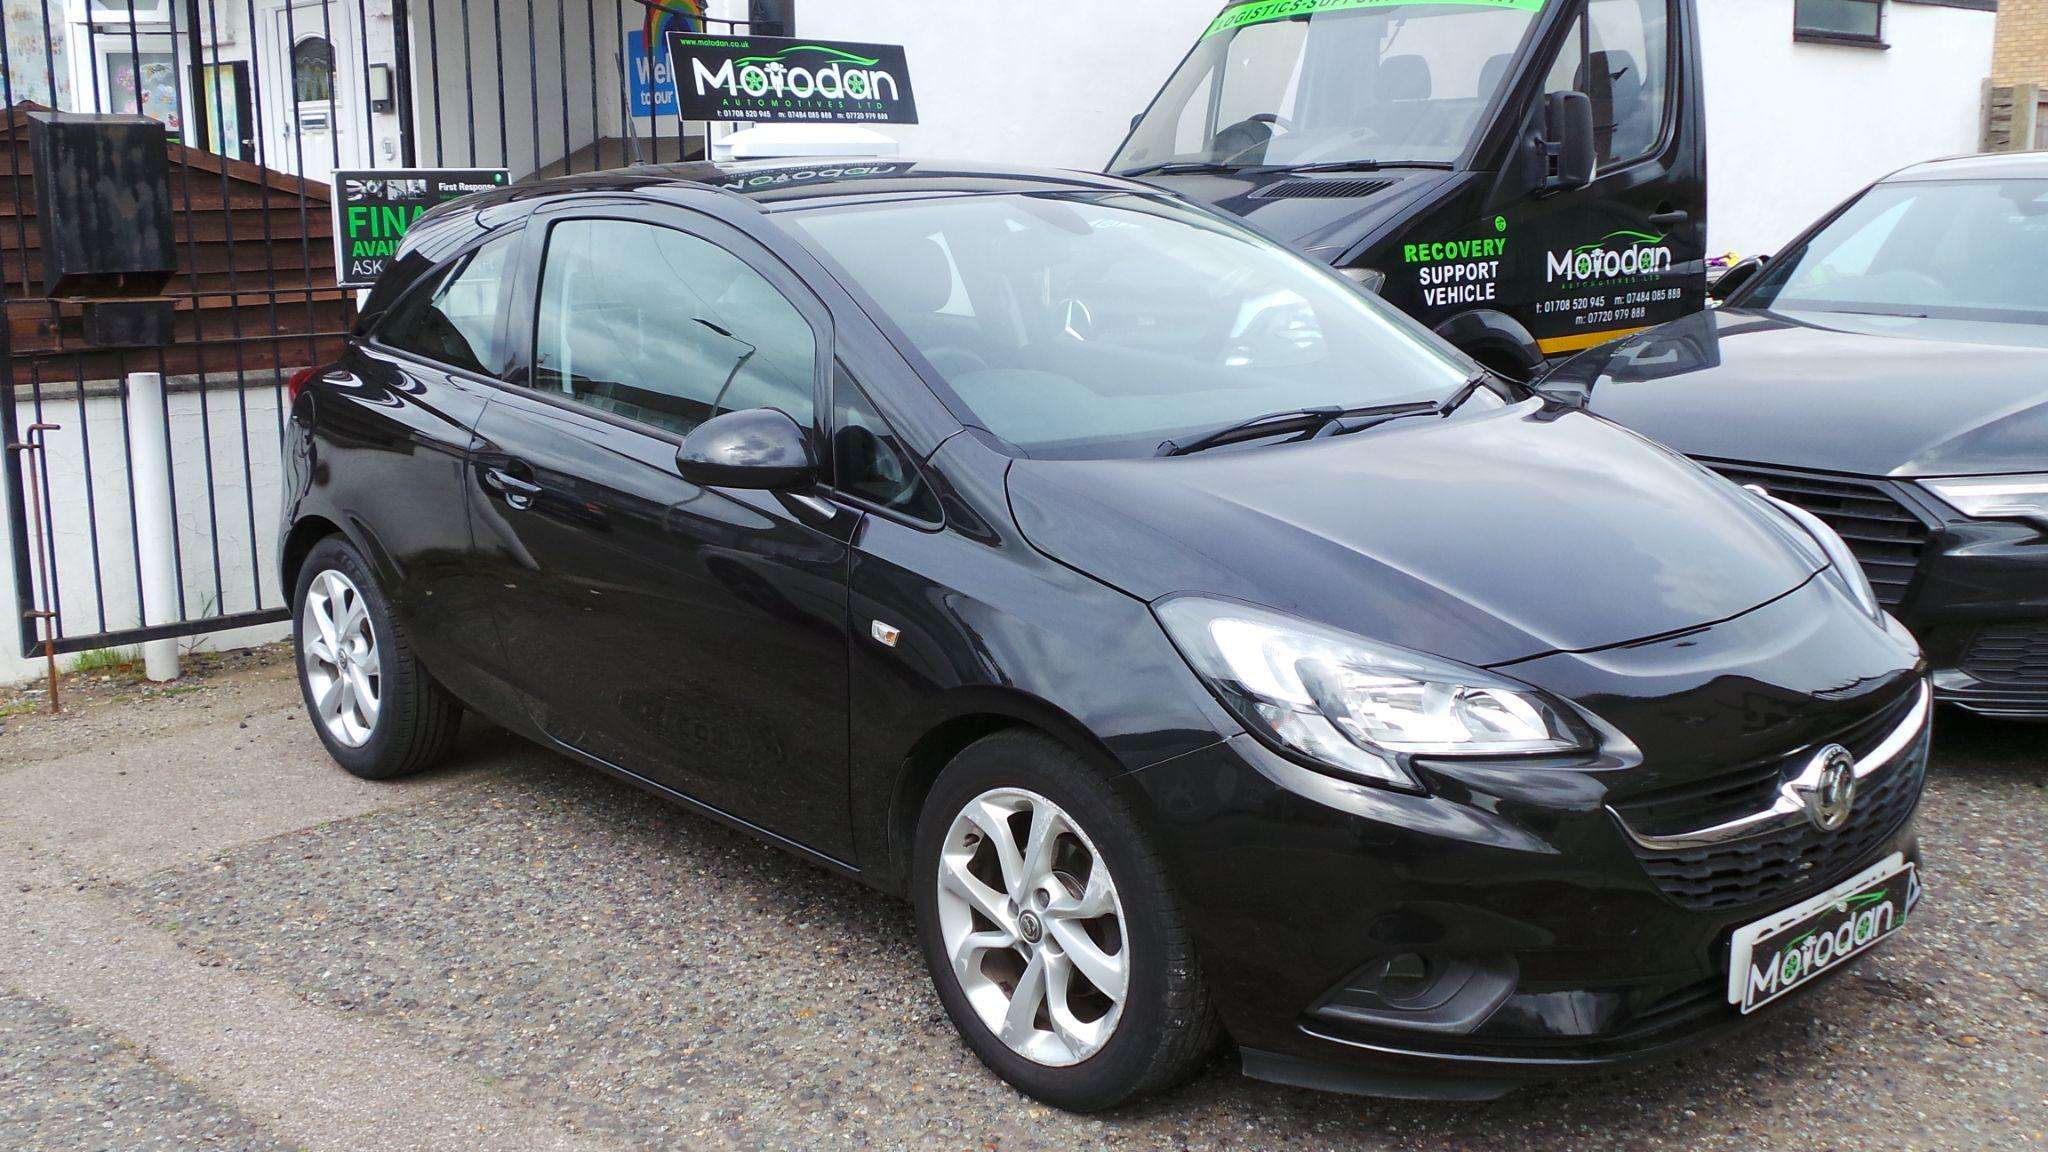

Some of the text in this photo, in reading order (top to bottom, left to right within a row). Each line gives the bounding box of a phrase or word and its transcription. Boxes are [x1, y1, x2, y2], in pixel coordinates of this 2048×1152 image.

[680, 38, 750, 48] www.motodan.co.uk
[691, 56, 900, 101] Motodan
[654, 90, 674, 104] our
[722, 98, 884, 109] AUTOMOTIVES LTD
[723, 109, 744, 118] 01708
[745, 110, 758, 118] 520
[758, 110, 771, 118] 945
[438, 182, 497, 193] First Response
[1404, 238, 1506, 263] RECOVERY
[351, 259, 384, 276] ASK
[1419, 260, 1500, 286] SUPPORT
[1546, 243, 1672, 283] Motodan
[1423, 282, 1496, 306] VEHICLE
[1536, 287, 1681, 314] t: 01708 520 945 m: 07484 085 888
[1575, 307, 1646, 325] m: 07720 979 888
[1747, 900, 1894, 1006] Motodan
